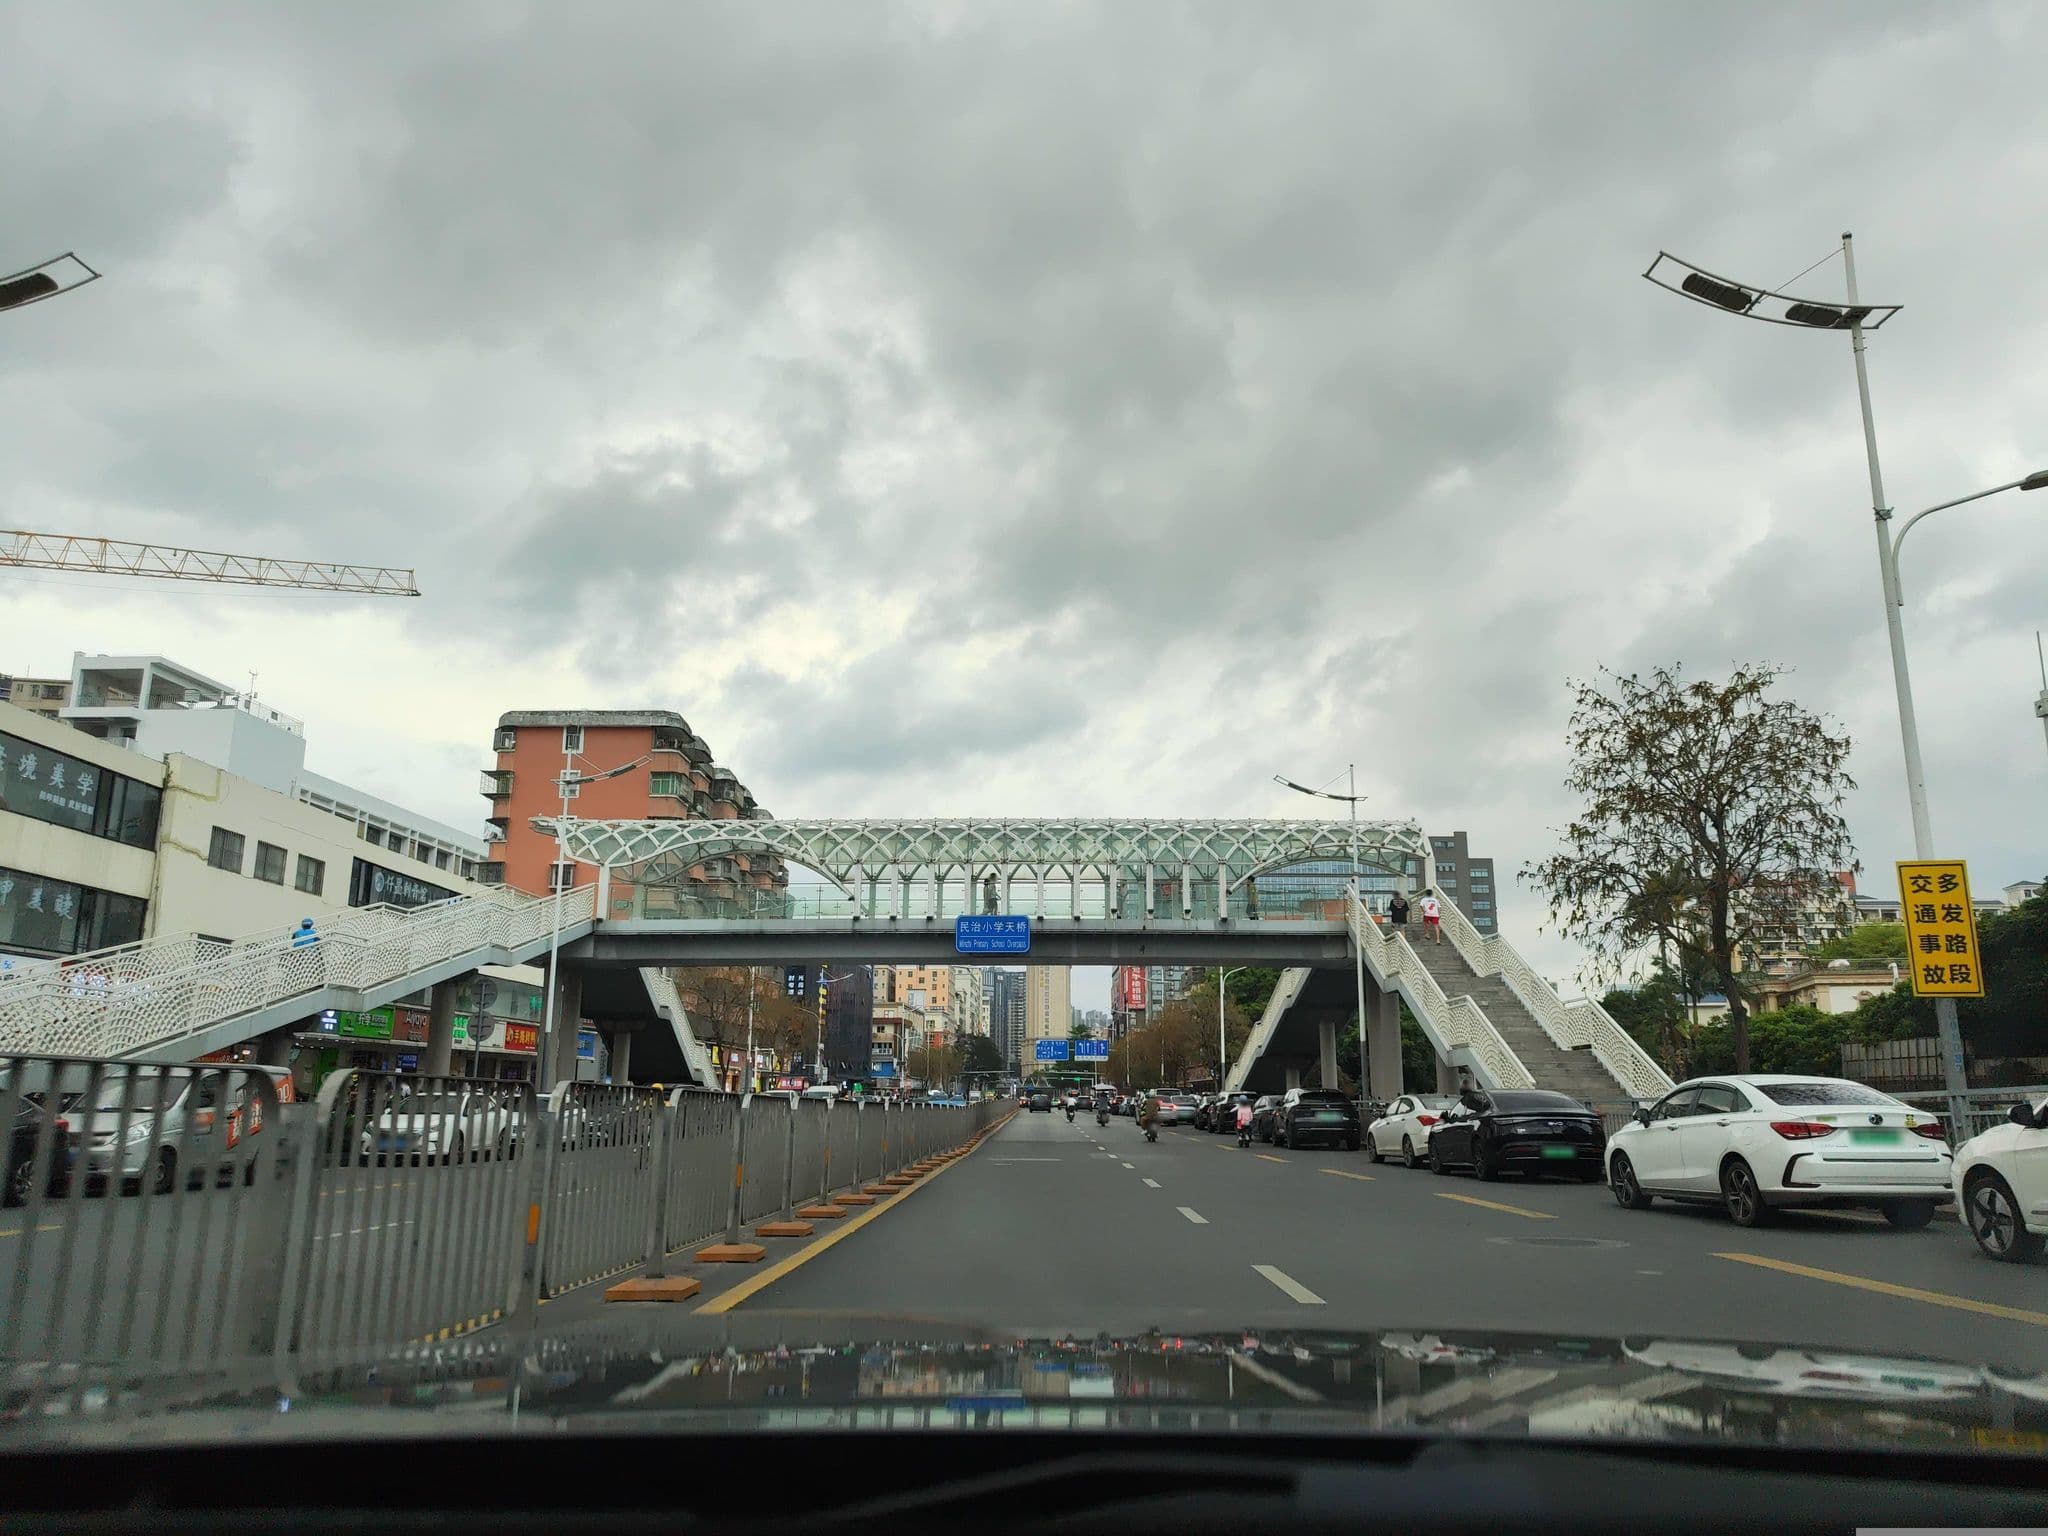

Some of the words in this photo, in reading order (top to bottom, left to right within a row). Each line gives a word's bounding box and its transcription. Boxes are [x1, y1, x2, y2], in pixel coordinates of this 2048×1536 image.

[960, 920, 1027, 933] 民治小学天桥
[973, 939, 989, 950] Primary
[991, 939, 1005, 948] School
[1007, 939, 1026, 950] Overpass
[1909, 873, 1946, 985] 交通事故
[1937, 873, 1972, 985] 多发路段
